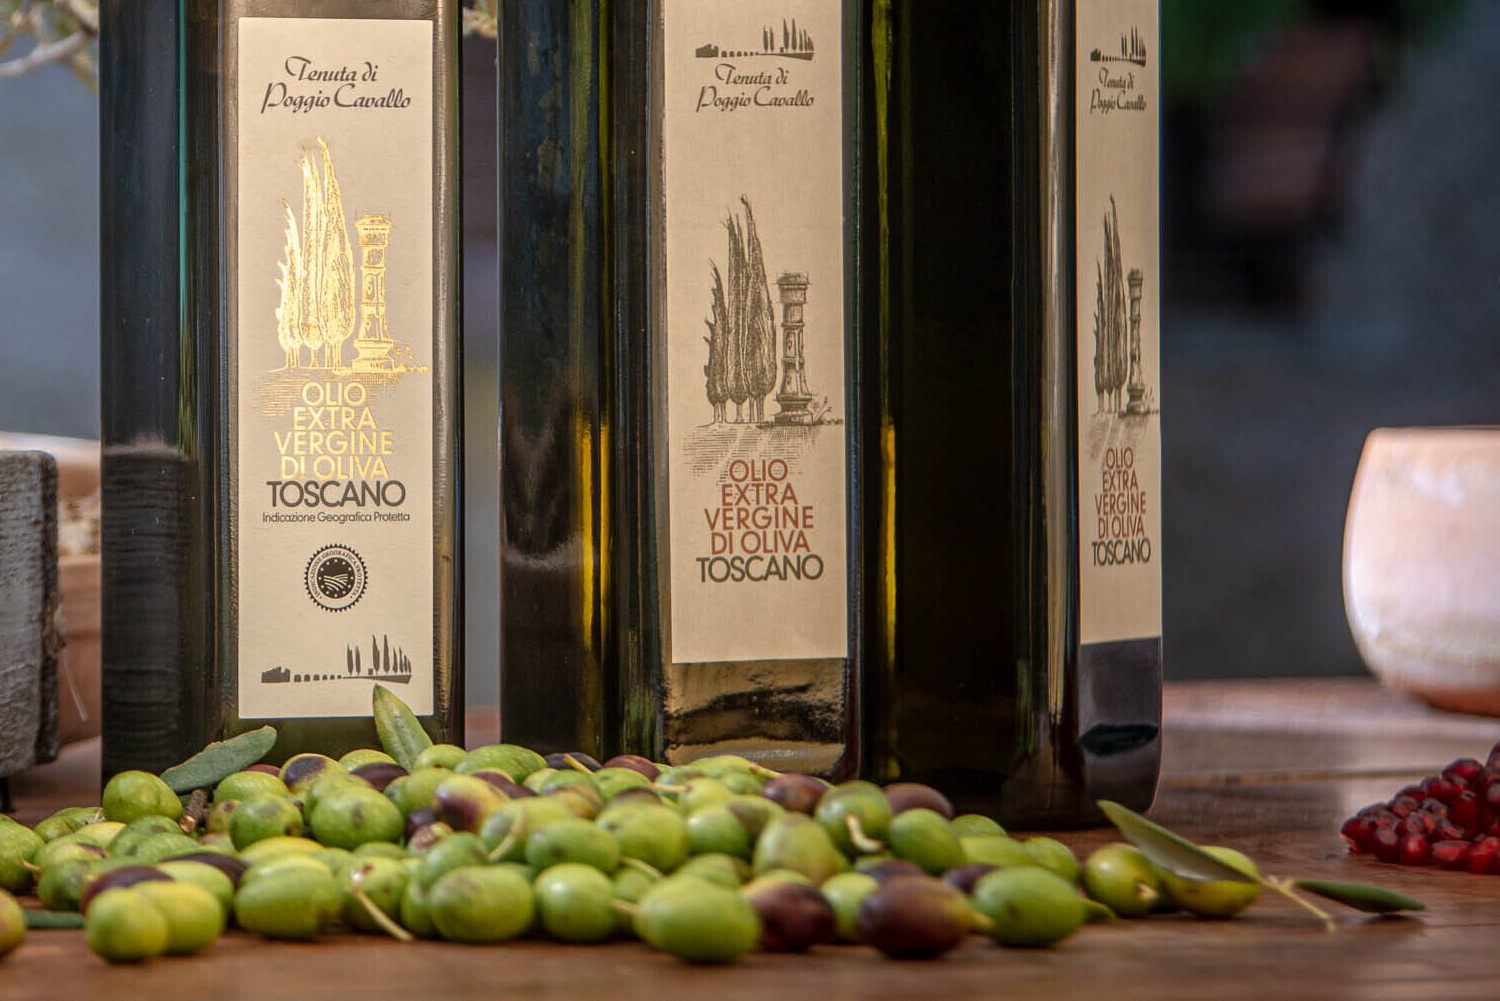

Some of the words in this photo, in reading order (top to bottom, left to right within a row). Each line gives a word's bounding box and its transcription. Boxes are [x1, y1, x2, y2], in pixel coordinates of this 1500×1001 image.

[284, 55, 357, 82] Tenuta
[362, 61, 379, 82] di
[715, 63, 772, 85] Tenuta
[775, 66, 789, 85] di
[1099, 66, 1126, 88] Tenuta
[1127, 71, 1135, 89] di
[261, 82, 331, 114] Poggio
[333, 82, 411, 109] Cavallo
[695, 85, 751, 113] Poggio
[753, 85, 815, 107] Cavallo
[1090, 87, 1116, 115] Poggio
[1116, 89, 1147, 111] Cavallo
[302, 382, 367, 407] OLIO
[293, 406, 378, 431] EXTRA
[274, 431, 395, 455] VERGINE
[281, 455, 305, 480] DI
[313, 455, 389, 480] OLIVA
[729, 458, 789, 483] OLIO
[1105, 447, 1134, 470] OLIO
[1102, 468, 1139, 493] EXTRA
[266, 480, 406, 508] TOSCANO
[722, 482, 799, 507] EXTRA
[1094, 491, 1146, 516] VERGINE
[263, 512, 316, 523] Indicazione
[317, 511, 372, 524] Geografica
[374, 511, 410, 522] Protetta
[704, 506, 814, 531] VERGINE
[1098, 517, 1108, 540] DI
[1111, 515, 1145, 539] OLIVA
[711, 531, 733, 555] DI
[740, 530, 811, 554] OLIVA
[1091, 538, 1151, 567] TOSCANO
[696, 554, 824, 583] TOSCANO
